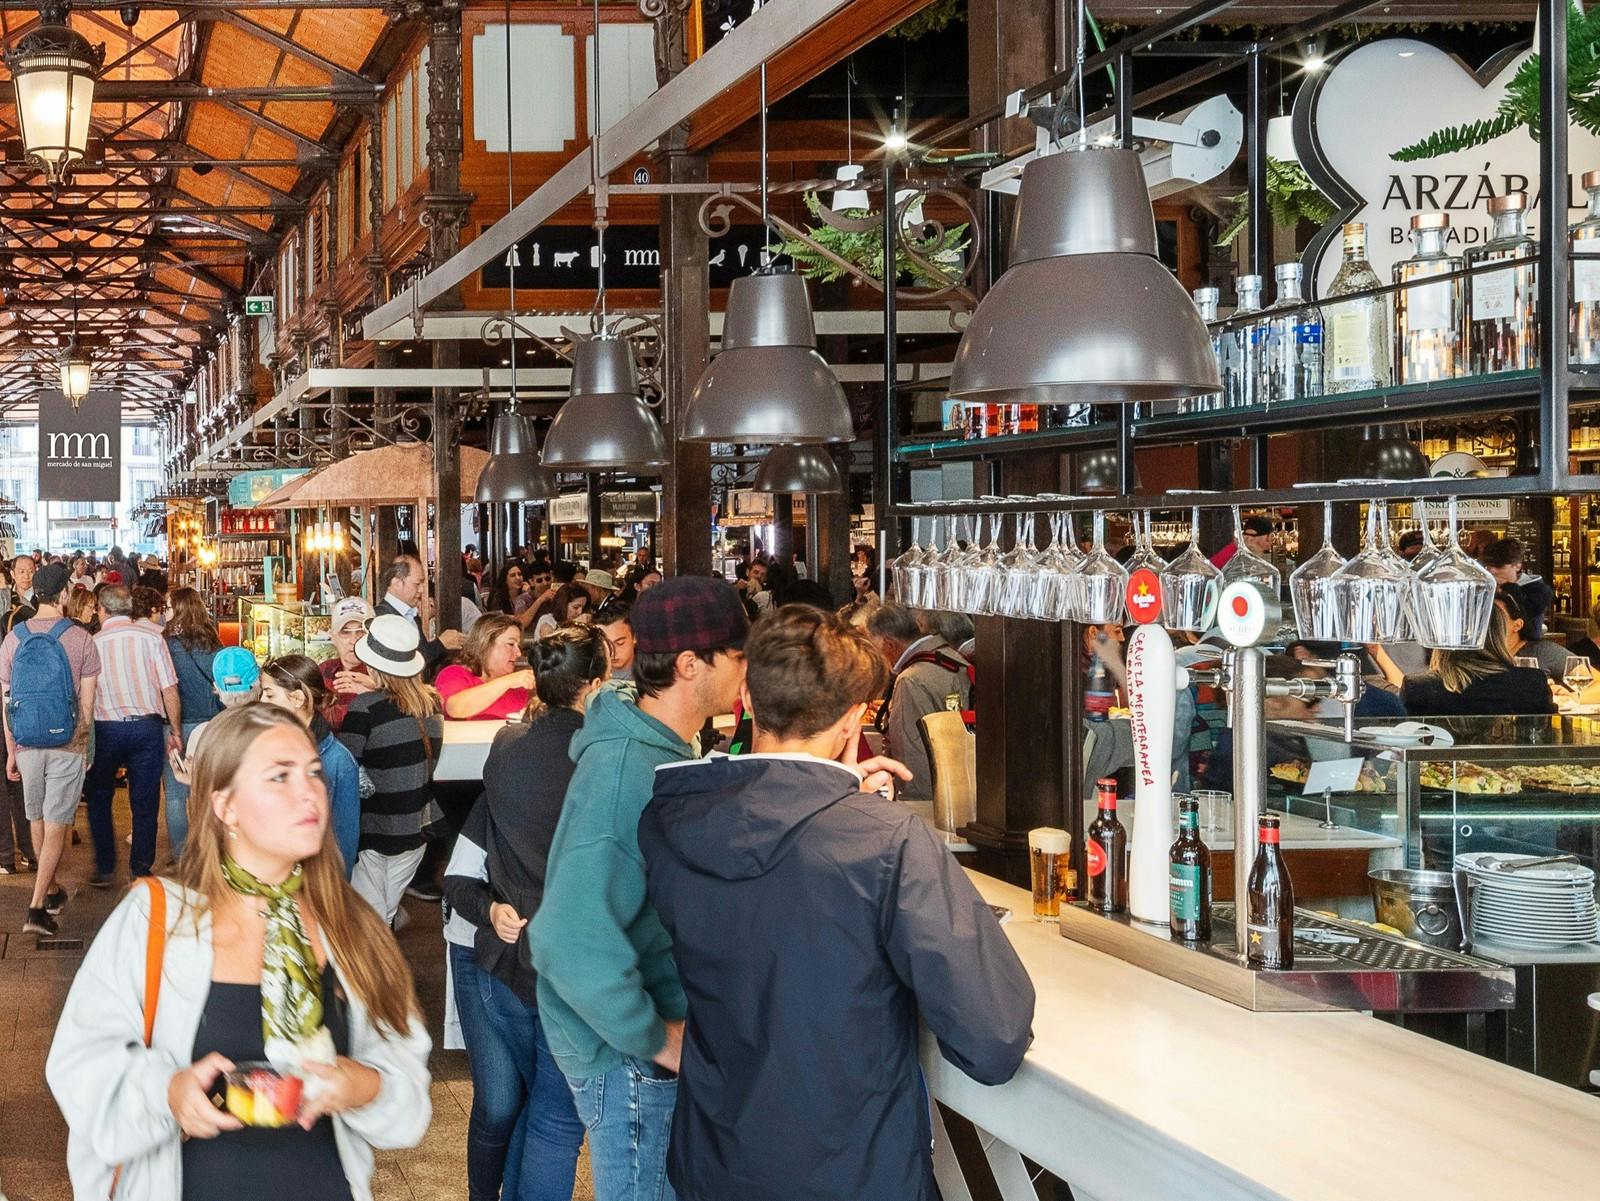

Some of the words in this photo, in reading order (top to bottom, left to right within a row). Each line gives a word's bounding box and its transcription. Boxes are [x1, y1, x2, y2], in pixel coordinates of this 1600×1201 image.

[635, 173, 648, 183] 40
[1382, 162, 1589, 210] ARZÁBL
[624, 249, 660, 266] mm
[47, 432, 113, 459] mm
[47, 460, 73, 468] mercado
[73, 460, 81, 468] de
[92, 460, 113, 470] miguel
[1477, 500, 1502, 509] WINE
[1135, 632, 1146, 688] CERVEZA
